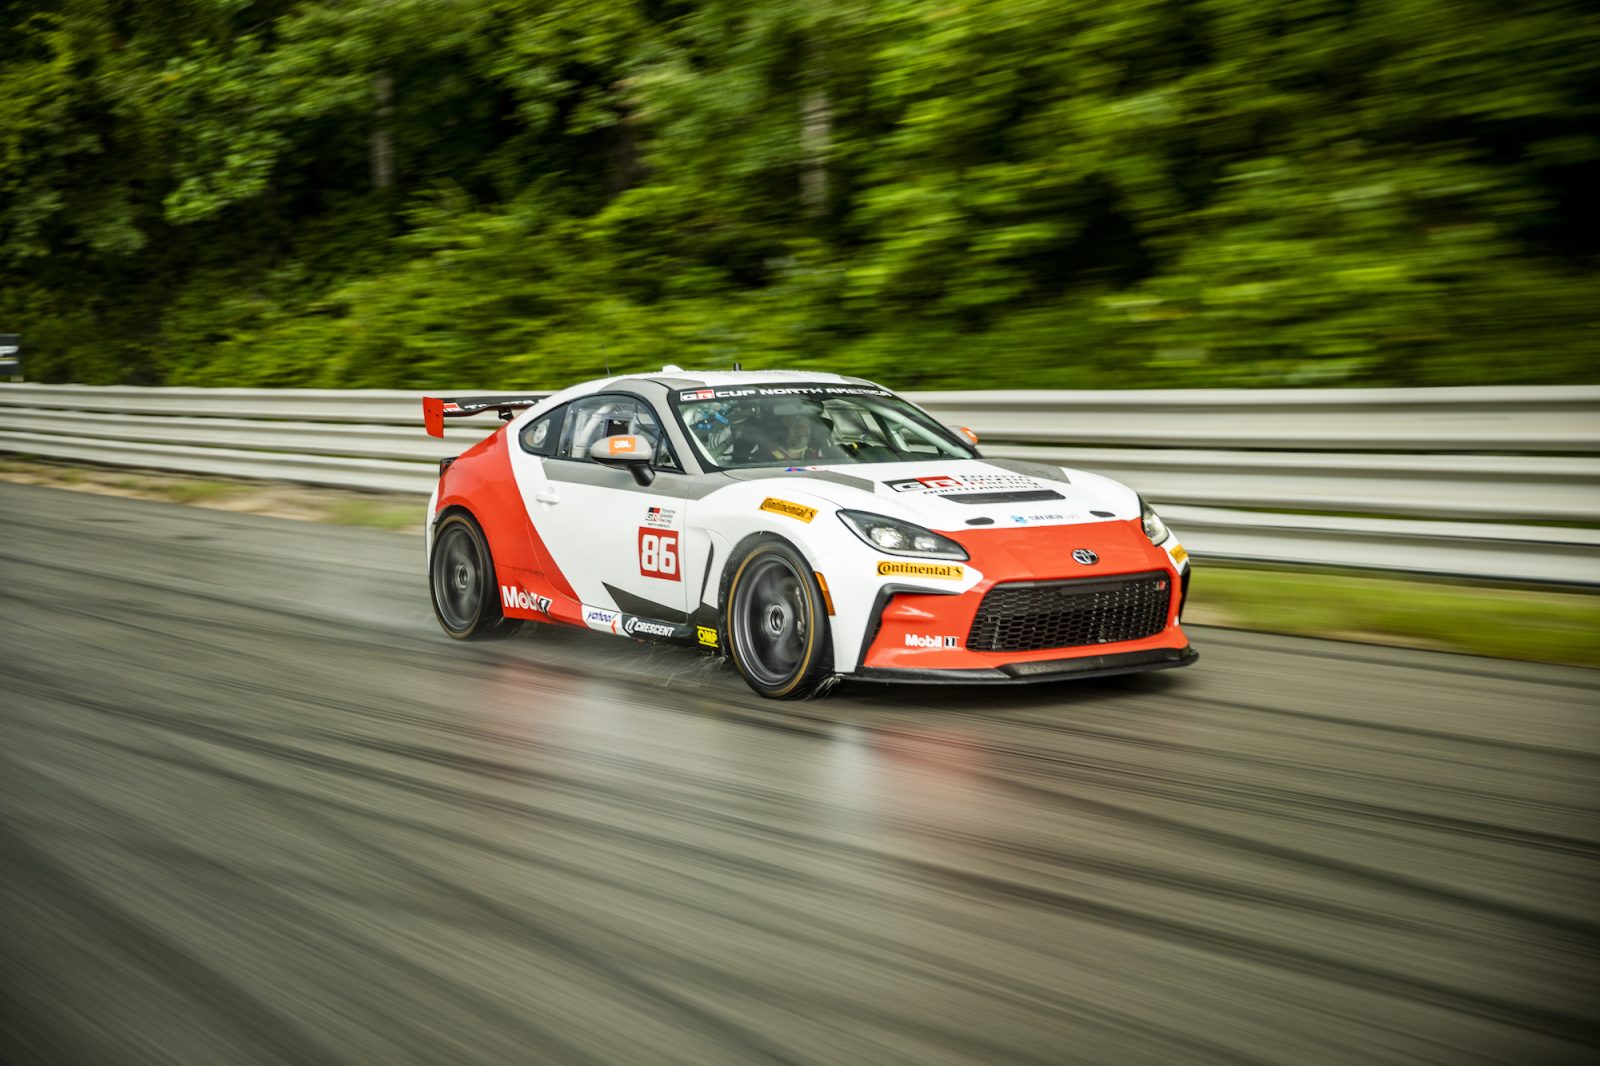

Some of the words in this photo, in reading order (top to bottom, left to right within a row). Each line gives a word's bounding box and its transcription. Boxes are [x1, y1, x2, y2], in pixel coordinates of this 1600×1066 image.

[716, 389, 755, 398] CUP
[759, 387, 823, 396] NORTH
[641, 534, 677, 575] 86
[878, 561, 950, 576] Continental
[634, 621, 675, 637] CRESCENT
[697, 629, 718, 644] OMP
[905, 633, 942, 649] Mobil
